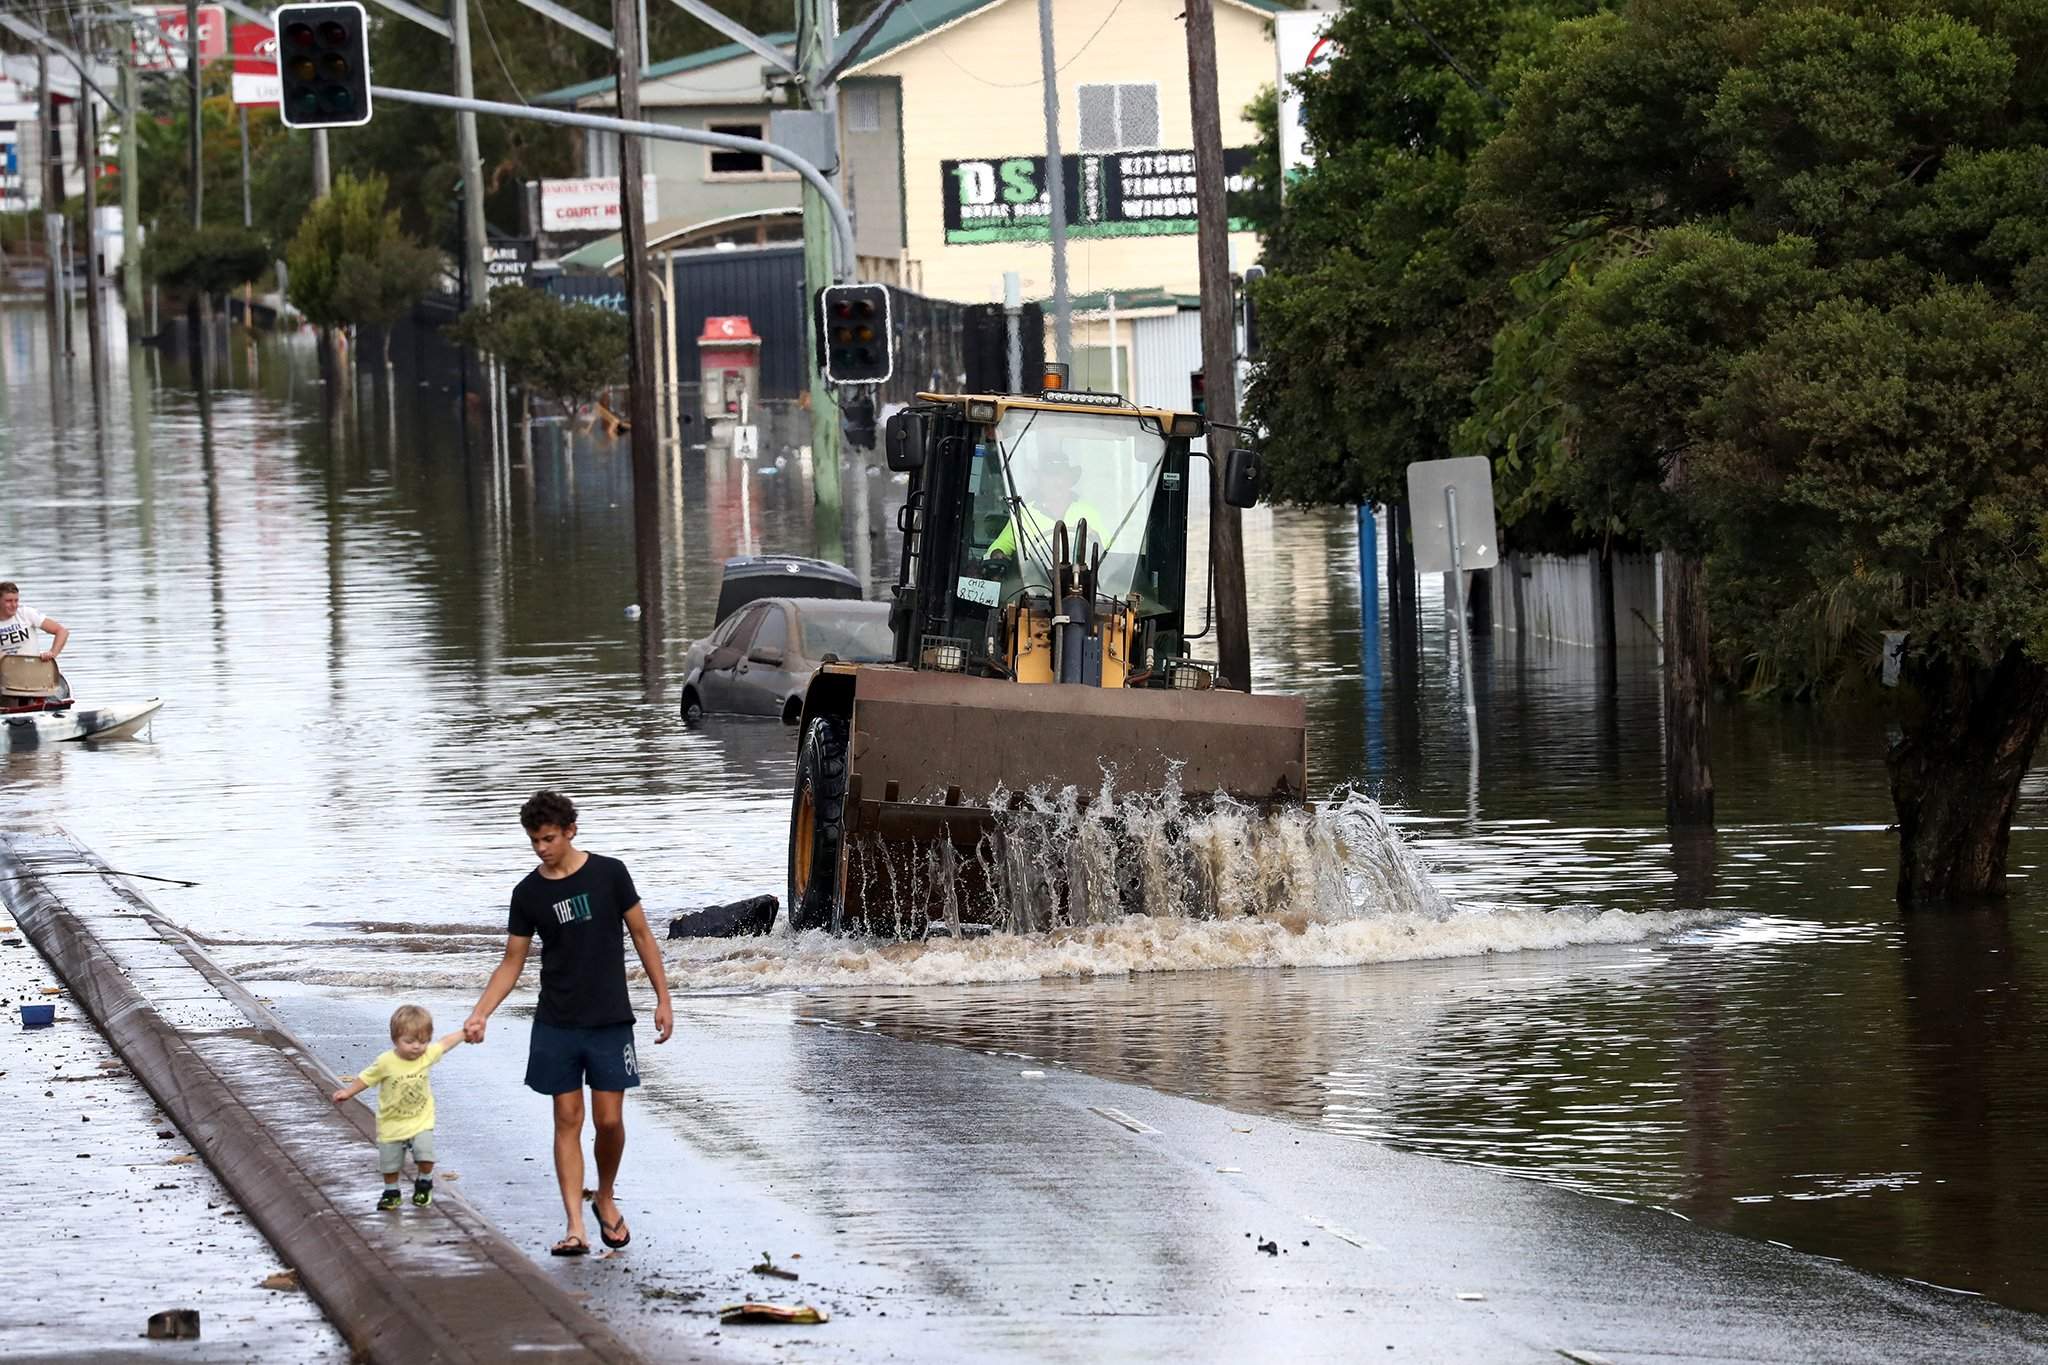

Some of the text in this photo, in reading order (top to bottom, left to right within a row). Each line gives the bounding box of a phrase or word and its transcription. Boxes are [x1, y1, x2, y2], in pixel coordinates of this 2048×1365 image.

[1120, 154, 1196, 175] KITCHE
[1122, 197, 1198, 218] WINDO
[0, 627, 29, 646] PEN
[552, 899, 576, 925] THE
